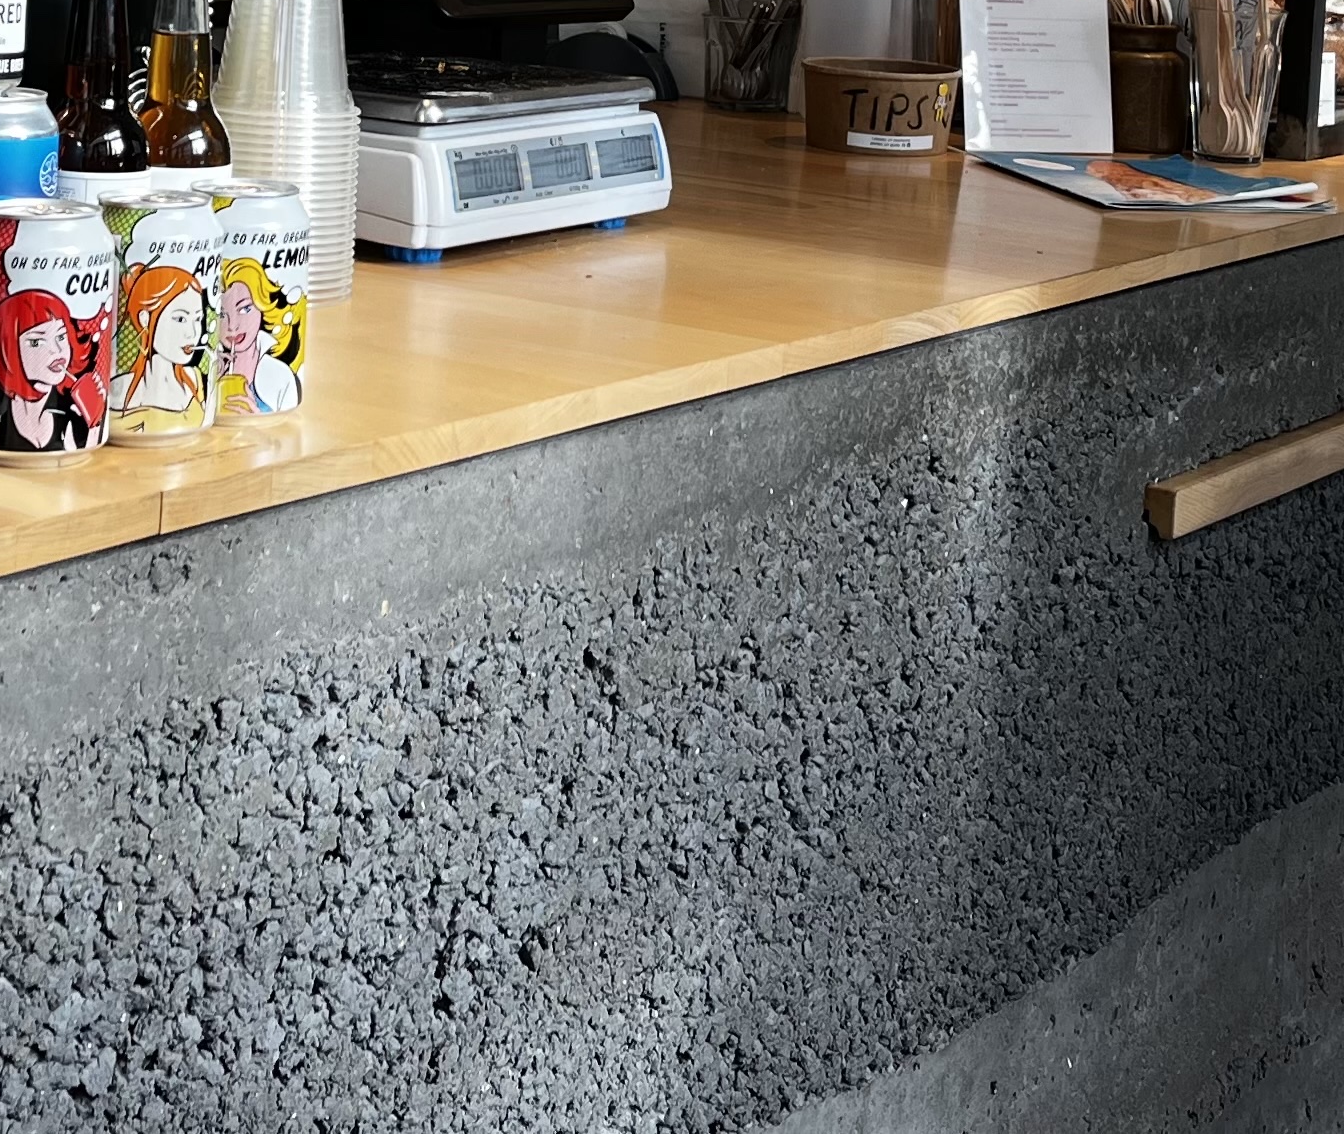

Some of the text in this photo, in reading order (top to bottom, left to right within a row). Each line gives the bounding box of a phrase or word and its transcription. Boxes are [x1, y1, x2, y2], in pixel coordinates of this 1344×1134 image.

[841, 88, 929, 132] TIPS
[149, 240, 211, 254] OH SO FAIR,
[232, 232, 279, 247] SO FAIR,
[11, 255, 83, 271] OH SO FAIR,
[65, 269, 110, 296] COLA
